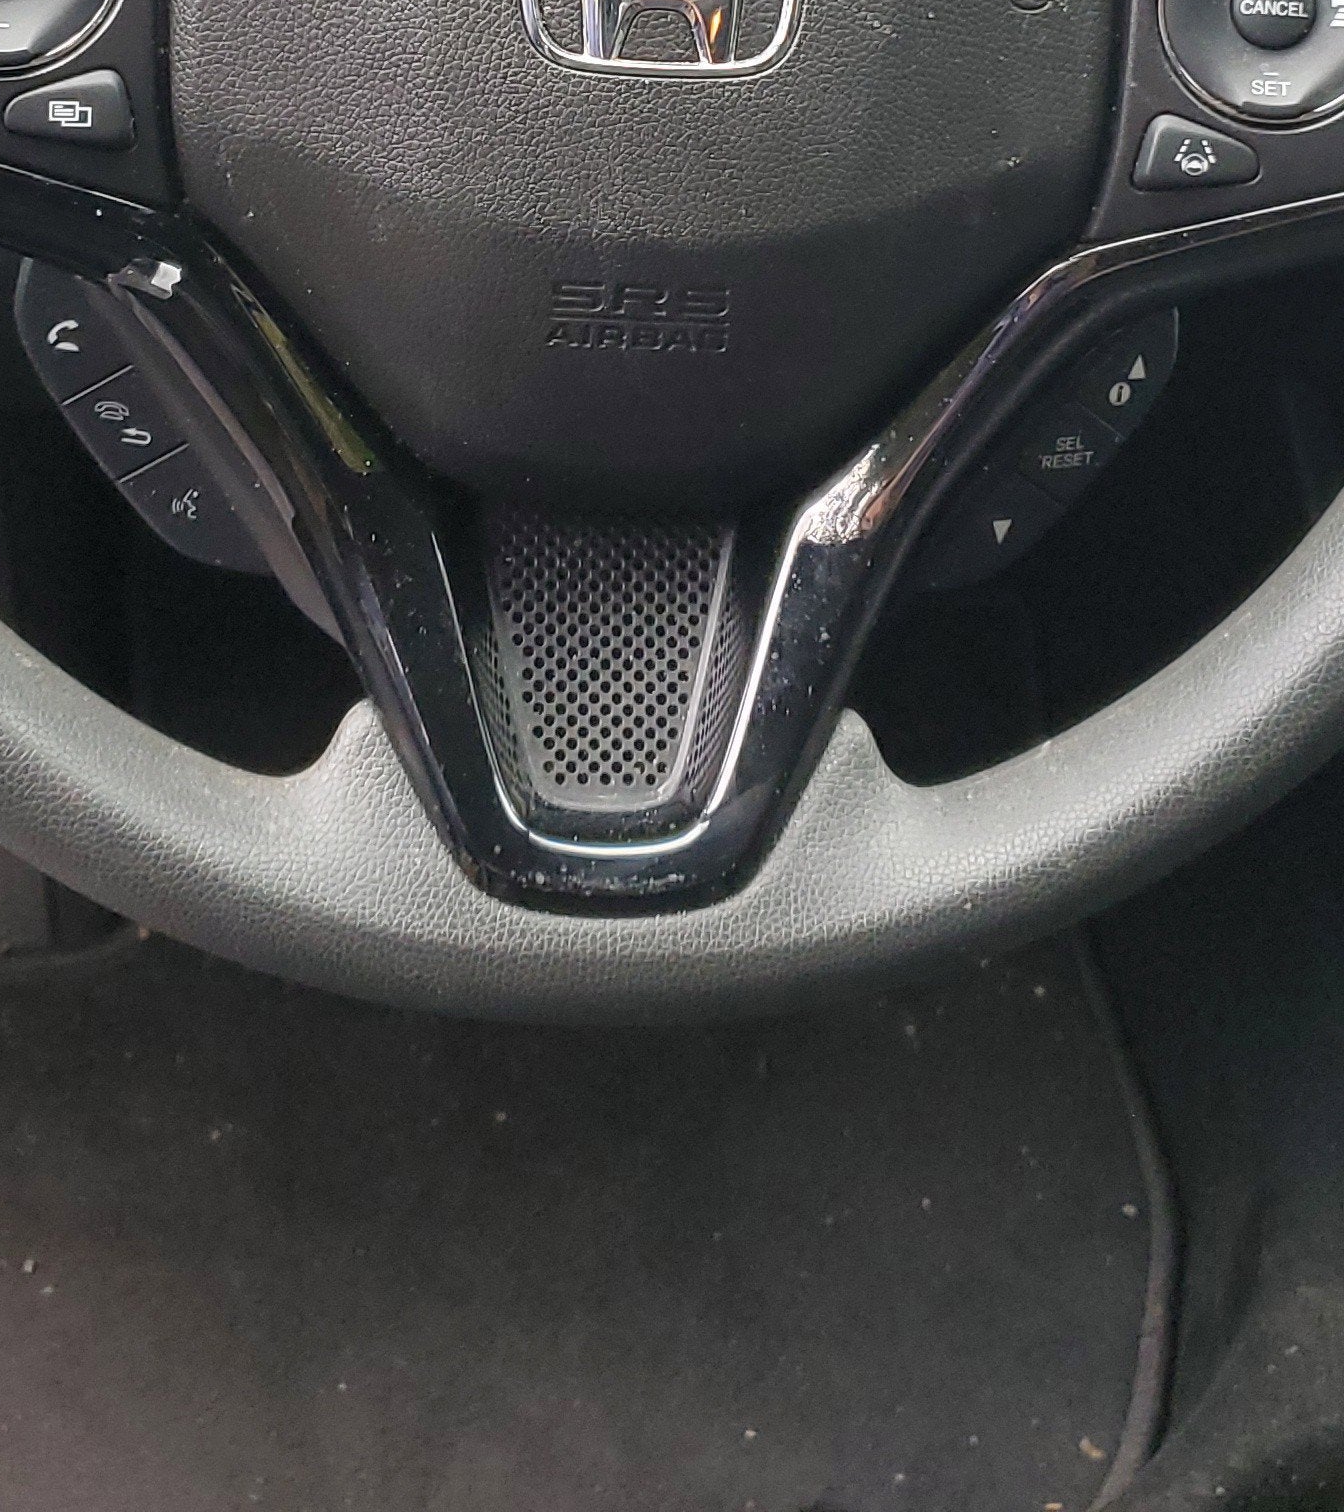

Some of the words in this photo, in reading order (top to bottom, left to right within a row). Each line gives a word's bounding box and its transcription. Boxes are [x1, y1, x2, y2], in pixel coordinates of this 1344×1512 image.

[1251, 78, 1291, 97] SET
[552, 285, 731, 318] SRS
[545, 326, 731, 354] AIRBAG
[1056, 436, 1085, 452] SEL
[1040, 451, 1095, 469] RESET
